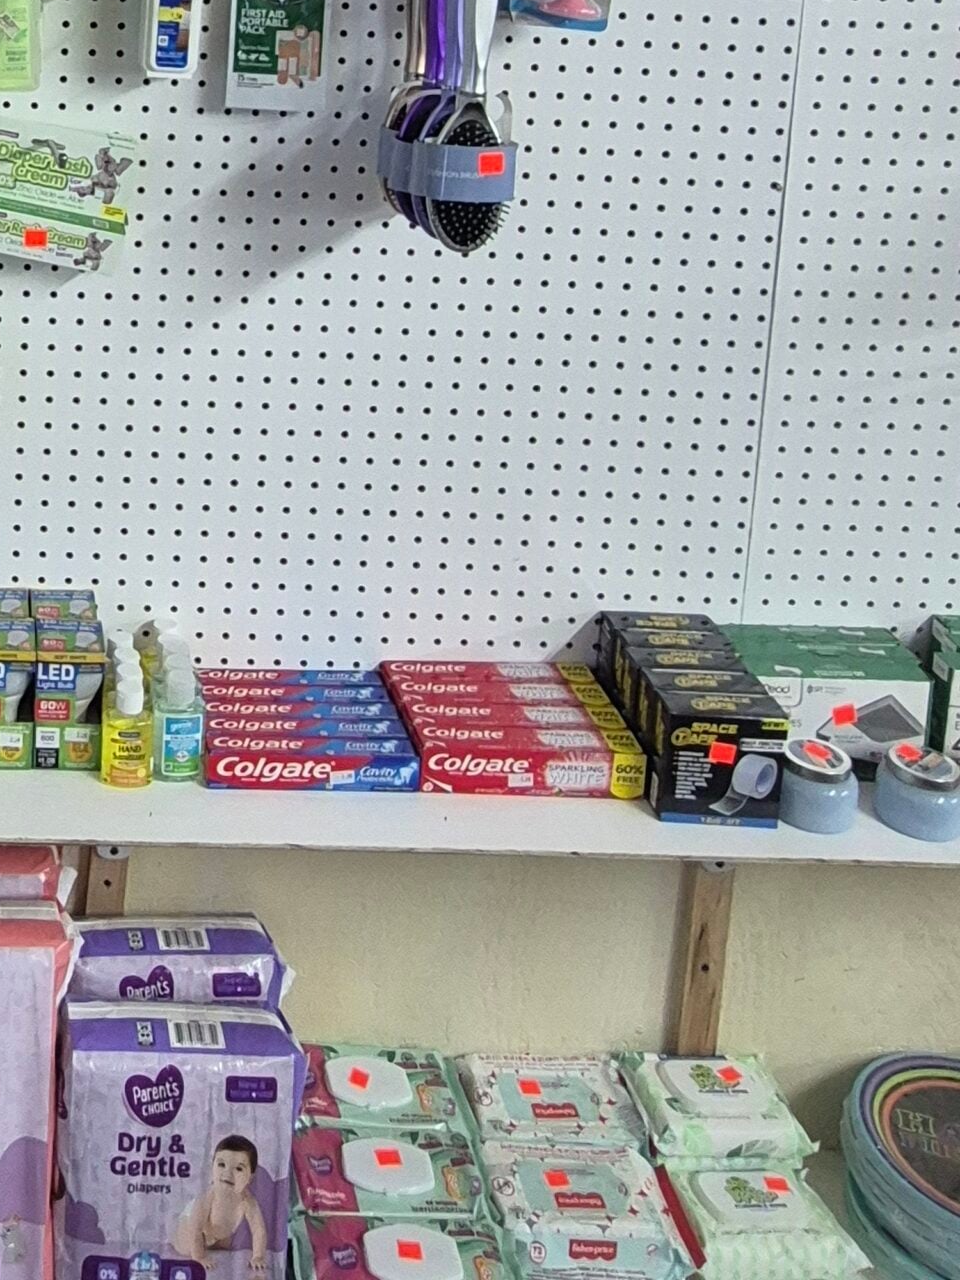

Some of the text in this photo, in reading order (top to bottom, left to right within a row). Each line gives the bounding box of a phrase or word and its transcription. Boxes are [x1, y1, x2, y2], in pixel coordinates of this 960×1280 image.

[241, 8, 286, 19] FIRST AID
[240, 17, 289, 28] PORTABLE
[239, 25, 266, 35] PACK
[37, 663, 75, 681] LED
[389, 662, 467, 673] Colgate
[37, 680, 75, 689] Light Bulb
[400, 681, 479, 693] Colgate
[202, 685, 285, 697] Colgate
[205, 702, 293, 714] Colgate
[411, 703, 492, 716] Colgate
[209, 718, 297, 731] Colgate
[691, 722, 739, 734] SPACE
[422, 727, 504, 740] Colgate
[213, 736, 304, 749] Colgate
[118, 745, 142, 753] HAND
[216, 756, 333, 782] Colgate
[427, 753, 530, 776] Colgate
[549, 764, 605, 774] SPARKLING
[616, 764, 644, 774] 60%
[359, 765, 398, 779] Cavity
[549, 773, 605, 785] WHITE
[616, 775, 640, 784] FREE
[126, 975, 170, 1000] Parent's
[132, 1079, 180, 1104] Parent's
[142, 1098, 175, 1115] CHOICE
[117, 1131, 186, 1158] Dry &
[110, 1156, 191, 1179] Gentle
[127, 1182, 172, 1196] Diapers
[99, 1269, 118, 1280] 0%
